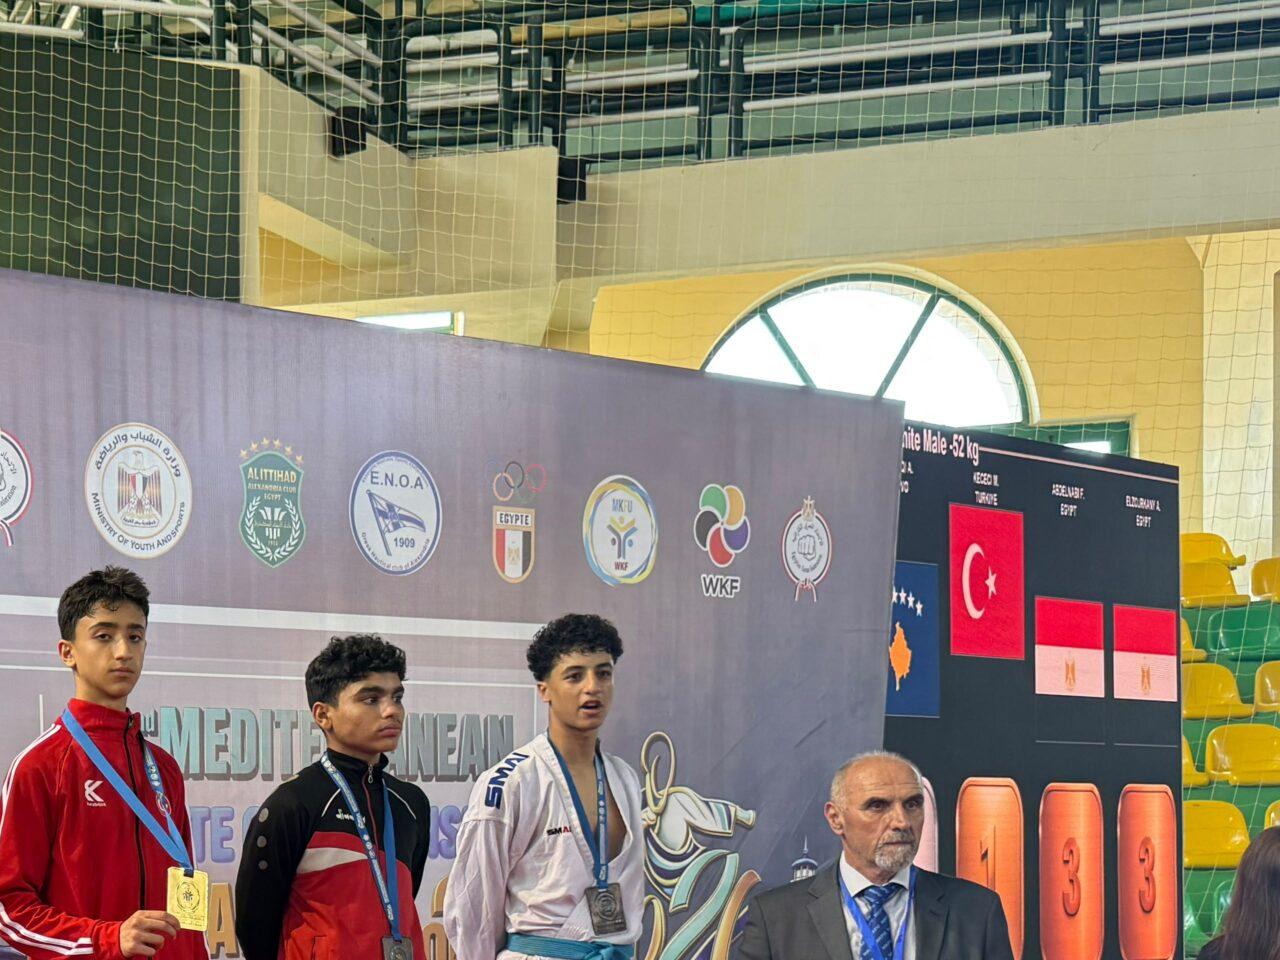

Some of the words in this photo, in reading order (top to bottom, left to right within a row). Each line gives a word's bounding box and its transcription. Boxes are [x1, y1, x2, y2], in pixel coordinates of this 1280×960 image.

[131, 431, 163, 448] الشباب
[923, 428, 947, 455] Male
[949, 433, 965, 458] -52
[966, 435, 979, 467] kg
[96, 434, 128, 471] والرياضة
[162, 447, 182, 478] وزارة
[370, 471, 424, 490] E.N.O.A
[612, 497, 633, 513] MKFU
[1060, 503, 1078, 517] EGYPT
[91, 492, 118, 538] MINISTRY
[117, 534, 130, 546] OF
[130, 540, 156, 551] YOUTH
[499, 512, 530, 526] EGYPTE
[1136, 514, 1152, 528] EGYPT
[393, 537, 416, 548] 1909
[614, 561, 629, 572] WKF
[702, 576, 740, 598] WKF
[484, 752, 530, 810] SMAI
[1062, 837, 1082, 917] 3
[1138, 836, 1157, 914] 3
